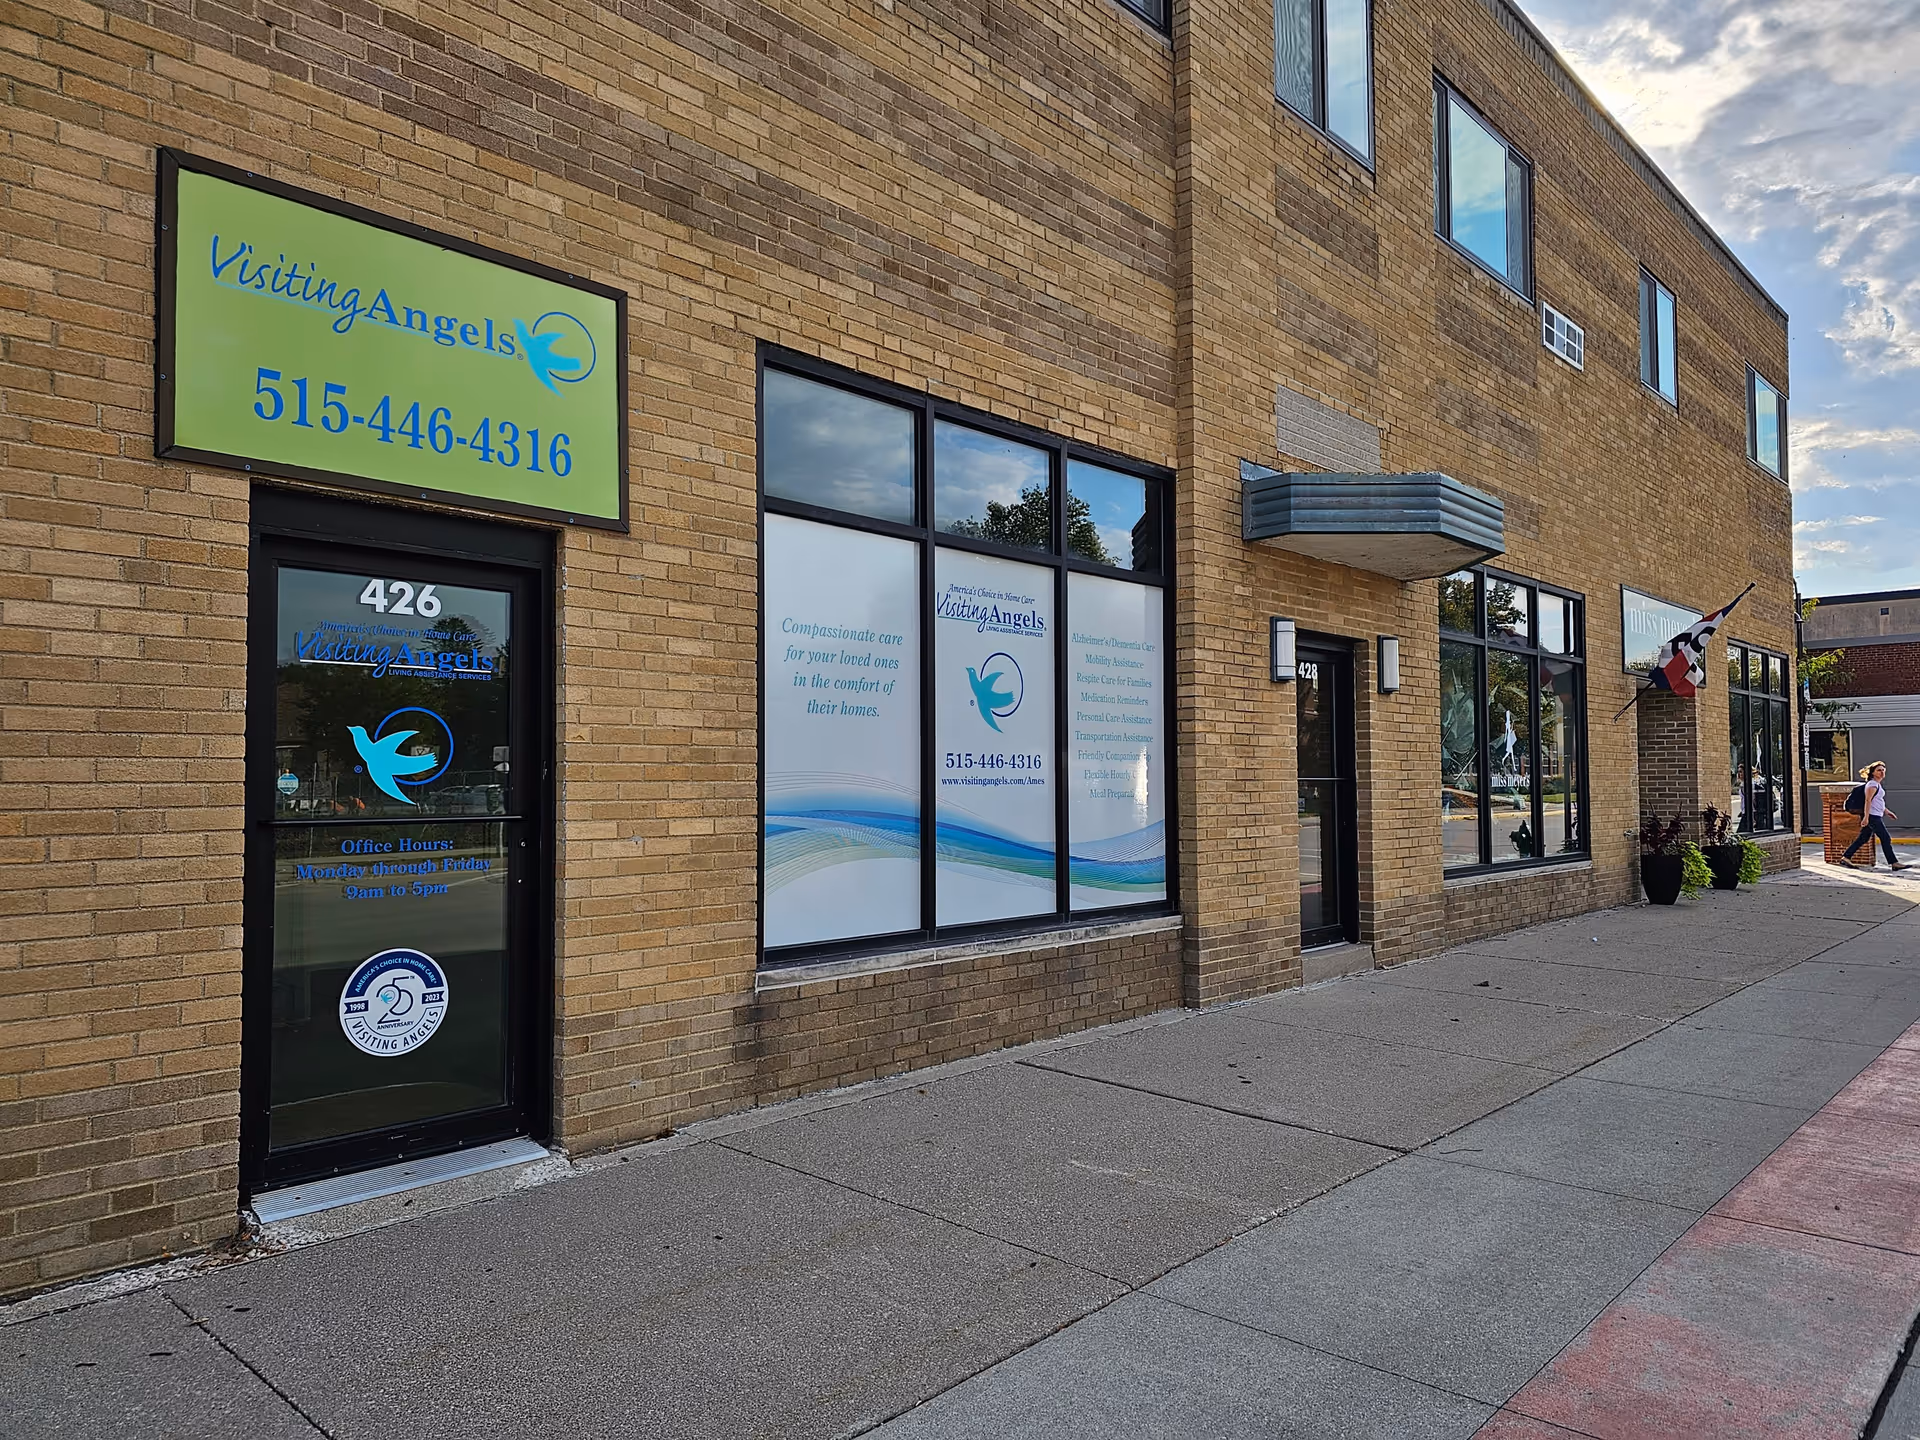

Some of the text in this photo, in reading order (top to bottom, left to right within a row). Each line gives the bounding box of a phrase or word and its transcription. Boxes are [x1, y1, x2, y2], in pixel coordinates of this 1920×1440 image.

[254, 366, 573, 478] 515-446-4316
[360, 578, 442, 618] 426
[947, 583, 1034, 605] America's Choice in Home Care
[1630, 600, 1657, 639] miss
[409, 628, 420, 638] in
[423, 628, 451, 641] Home
[782, 617, 904, 646] Compassionate care
[986, 625, 1044, 638] LIVING ASSISTANCE SERVICES
[1141, 641, 1156, 652] Care
[783, 644, 900, 669] for your loved ones
[1085, 653, 1145, 669] Mobility Assistance
[388, 668, 492, 681] LIVING ASSISTANCE SERVICES
[1298, 661, 1318, 680] 428
[793, 671, 896, 696] in the comfort of
[1076, 672, 1152, 688] Respite Care for Families
[1080, 691, 1149, 706] Medication Reminders
[806, 698, 880, 718] their homes.
[1076, 711, 1153, 725] Personal Care Assistance
[1074, 730, 1154, 743] Transportation Assistance
[945, 752, 1042, 769] 515-446-4316
[1078, 749, 1104, 761] Friendly
[941, 776, 1045, 787] www.visitingangels.com/Ames
[1084, 769, 1109, 780] Flexible
[1110, 769, 1131, 781] Hourly
[1491, 772, 1507, 788] miss
[1089, 788, 1106, 799] Meal
[340, 837, 454, 855] Office Hours:
[296, 856, 492, 880] Monday through Friday
[346, 881, 449, 900] 9am to 5pm
[355, 964, 380, 993] AMERICA'S
[379, 957, 403, 969] CHOICE
[410, 958, 426, 971] HOME
[424, 968, 436, 984] CARE
[424, 993, 440, 1002] 2023
[349, 1003, 366, 1012] 1998
[352, 1010, 439, 1050] VISITING ANGELS
[376, 1020, 415, 1031] ANNIVERSARY
